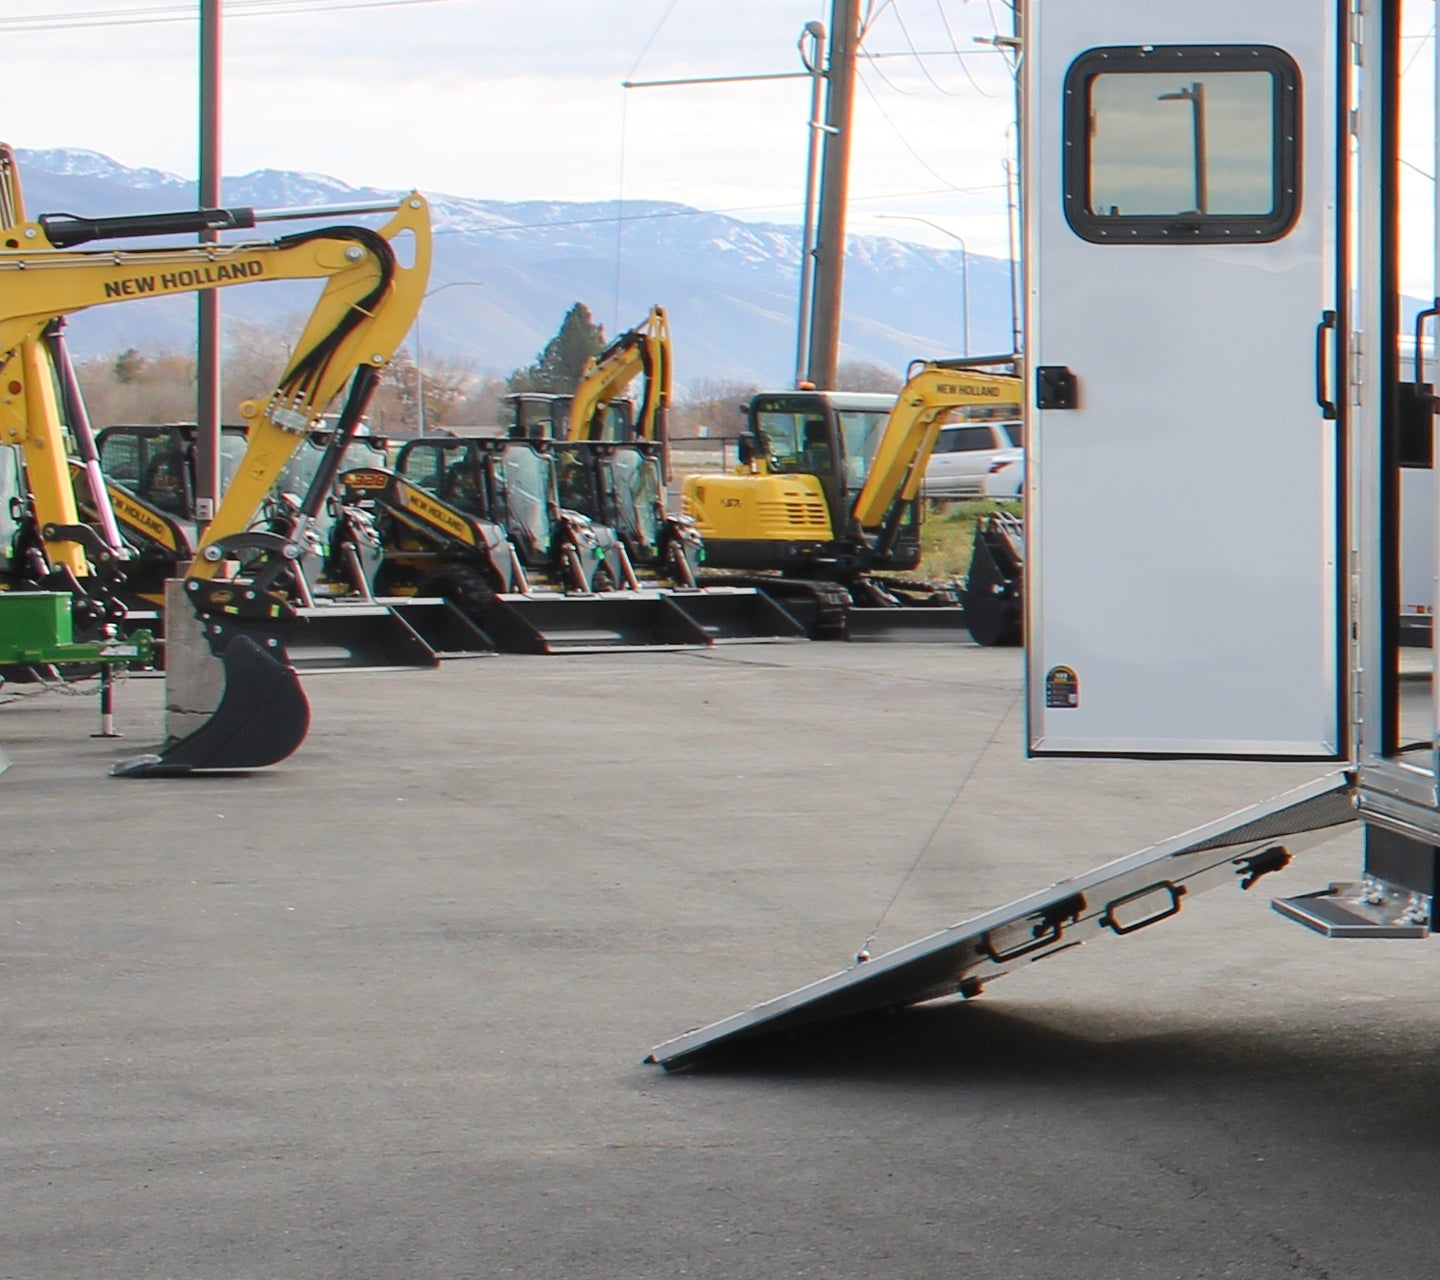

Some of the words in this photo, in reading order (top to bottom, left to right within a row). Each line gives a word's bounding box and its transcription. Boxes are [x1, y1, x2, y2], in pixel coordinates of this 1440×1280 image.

[104, 276, 155, 298] NEW
[161, 260, 263, 289] HOLLAND
[936, 384, 957, 394] NEW
[959, 385, 1000, 397] HOLLAND
